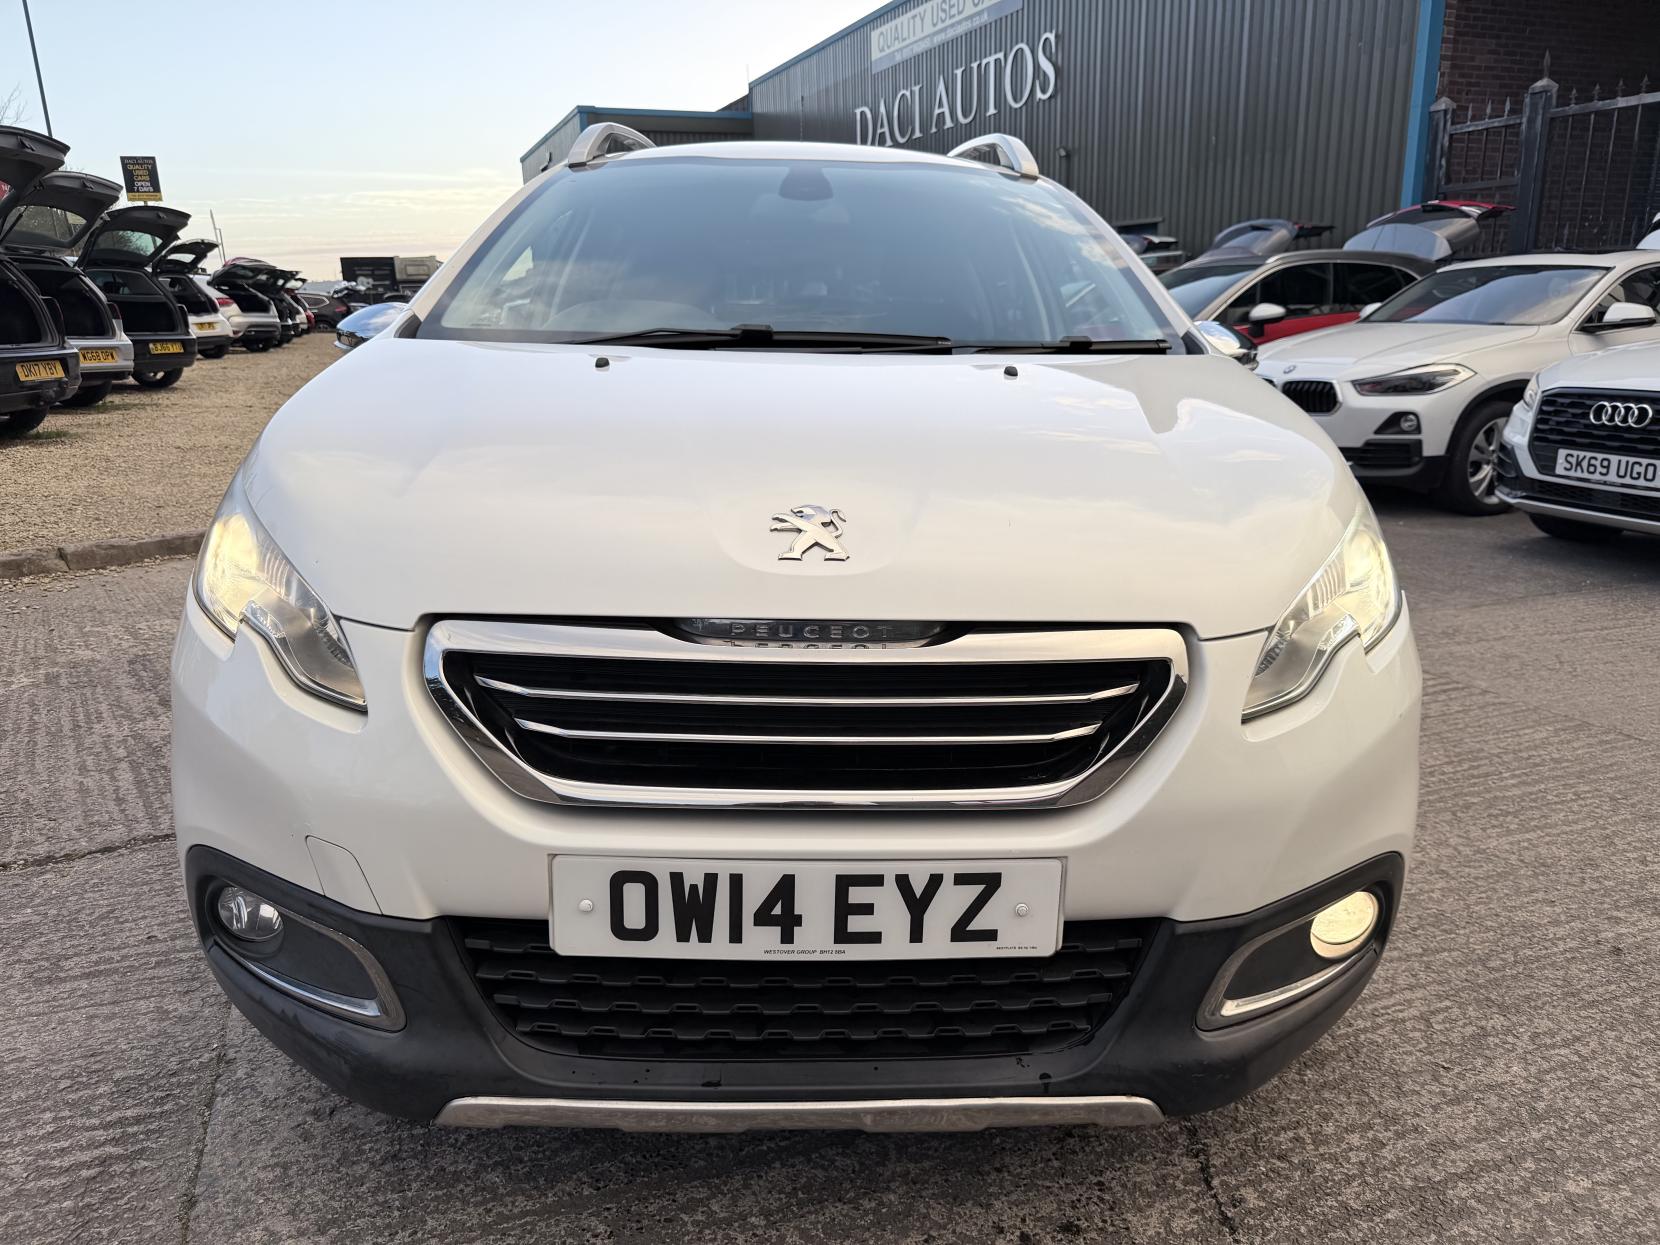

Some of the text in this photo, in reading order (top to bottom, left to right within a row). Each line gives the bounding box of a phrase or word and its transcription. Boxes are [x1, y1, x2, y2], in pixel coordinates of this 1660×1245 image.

[877, 8, 927, 53] QUALITY
[931, 0, 966, 28] USED
[855, 79, 924, 146] DACI
[930, 29, 1056, 133] AUTOS
[20, 363, 42, 378] DK17
[1563, 453, 1658, 482] SK69 UGO
[730, 623, 894, 639] PEUGEOT
[609, 870, 1003, 945] OW14 EYZ
